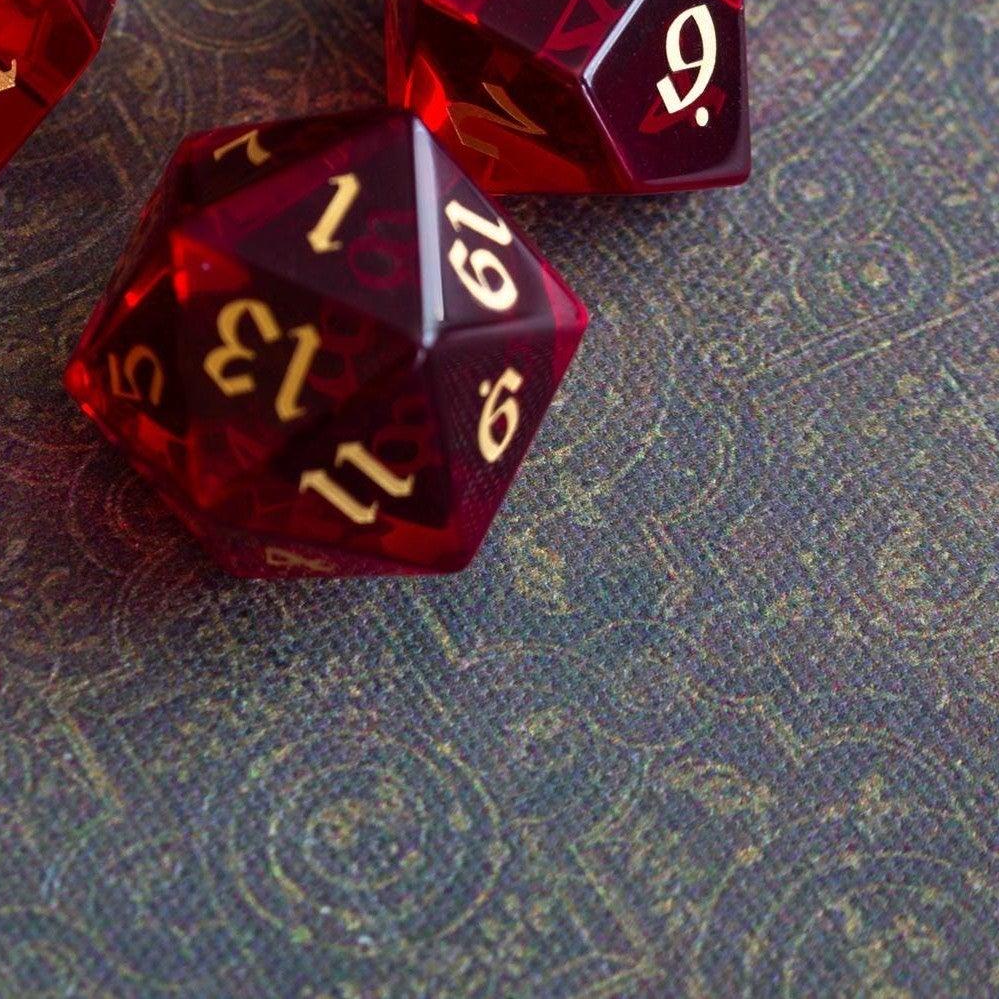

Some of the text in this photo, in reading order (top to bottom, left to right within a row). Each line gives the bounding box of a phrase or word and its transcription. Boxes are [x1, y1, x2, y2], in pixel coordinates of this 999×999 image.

[306, 172, 361, 254] 1
[444, 200, 519, 312] 19
[202, 298, 323, 423] 13
[299, 440, 415, 526] 11
